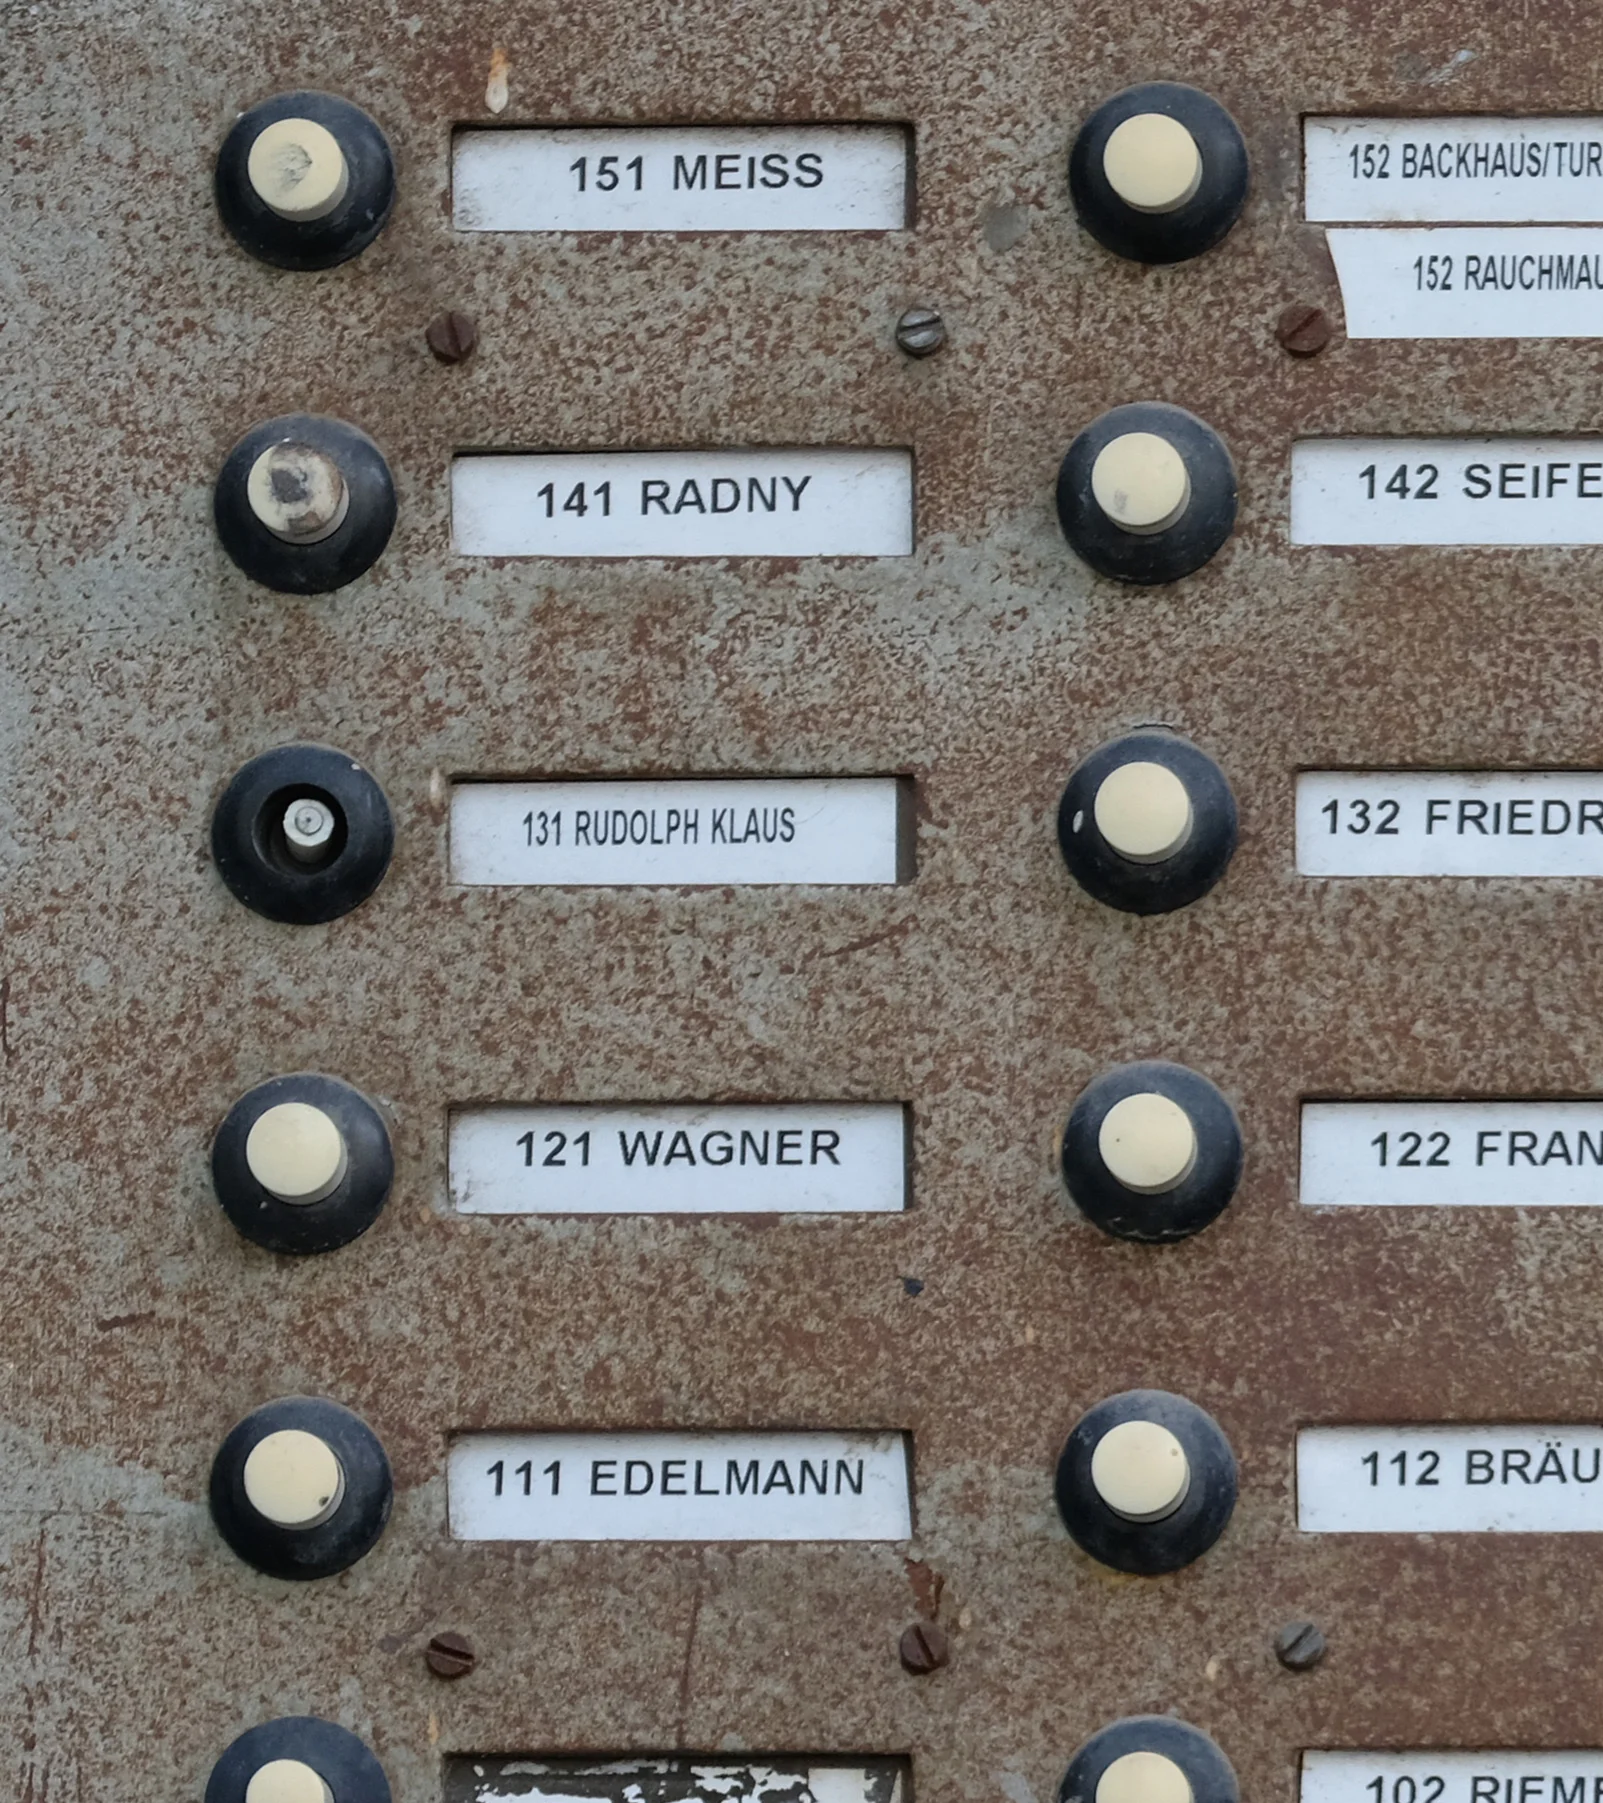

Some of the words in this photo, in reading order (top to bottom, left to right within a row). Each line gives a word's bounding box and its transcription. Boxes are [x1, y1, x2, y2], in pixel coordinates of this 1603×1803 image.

[569, 155, 643, 192] 151
[673, 152, 824, 190] MEISS
[1349, 143, 1390, 179] 152
[1413, 255, 1454, 291] 152
[537, 481, 611, 518] 141
[641, 475, 812, 516] RADNY
[1359, 463, 1439, 500] 142
[523, 810, 562, 847] 131
[575, 808, 699, 846] RUDOLPH
[711, 807, 796, 844] KLAUS
[1321, 798, 1401, 835] 132
[516, 1130, 591, 1167] 121
[618, 1129, 840, 1167] WAGNER
[1371, 1131, 1451, 1167] 122
[486, 1460, 561, 1497] 111
[590, 1459, 864, 1496] EDELMANN
[1362, 1449, 1440, 1487] 112
